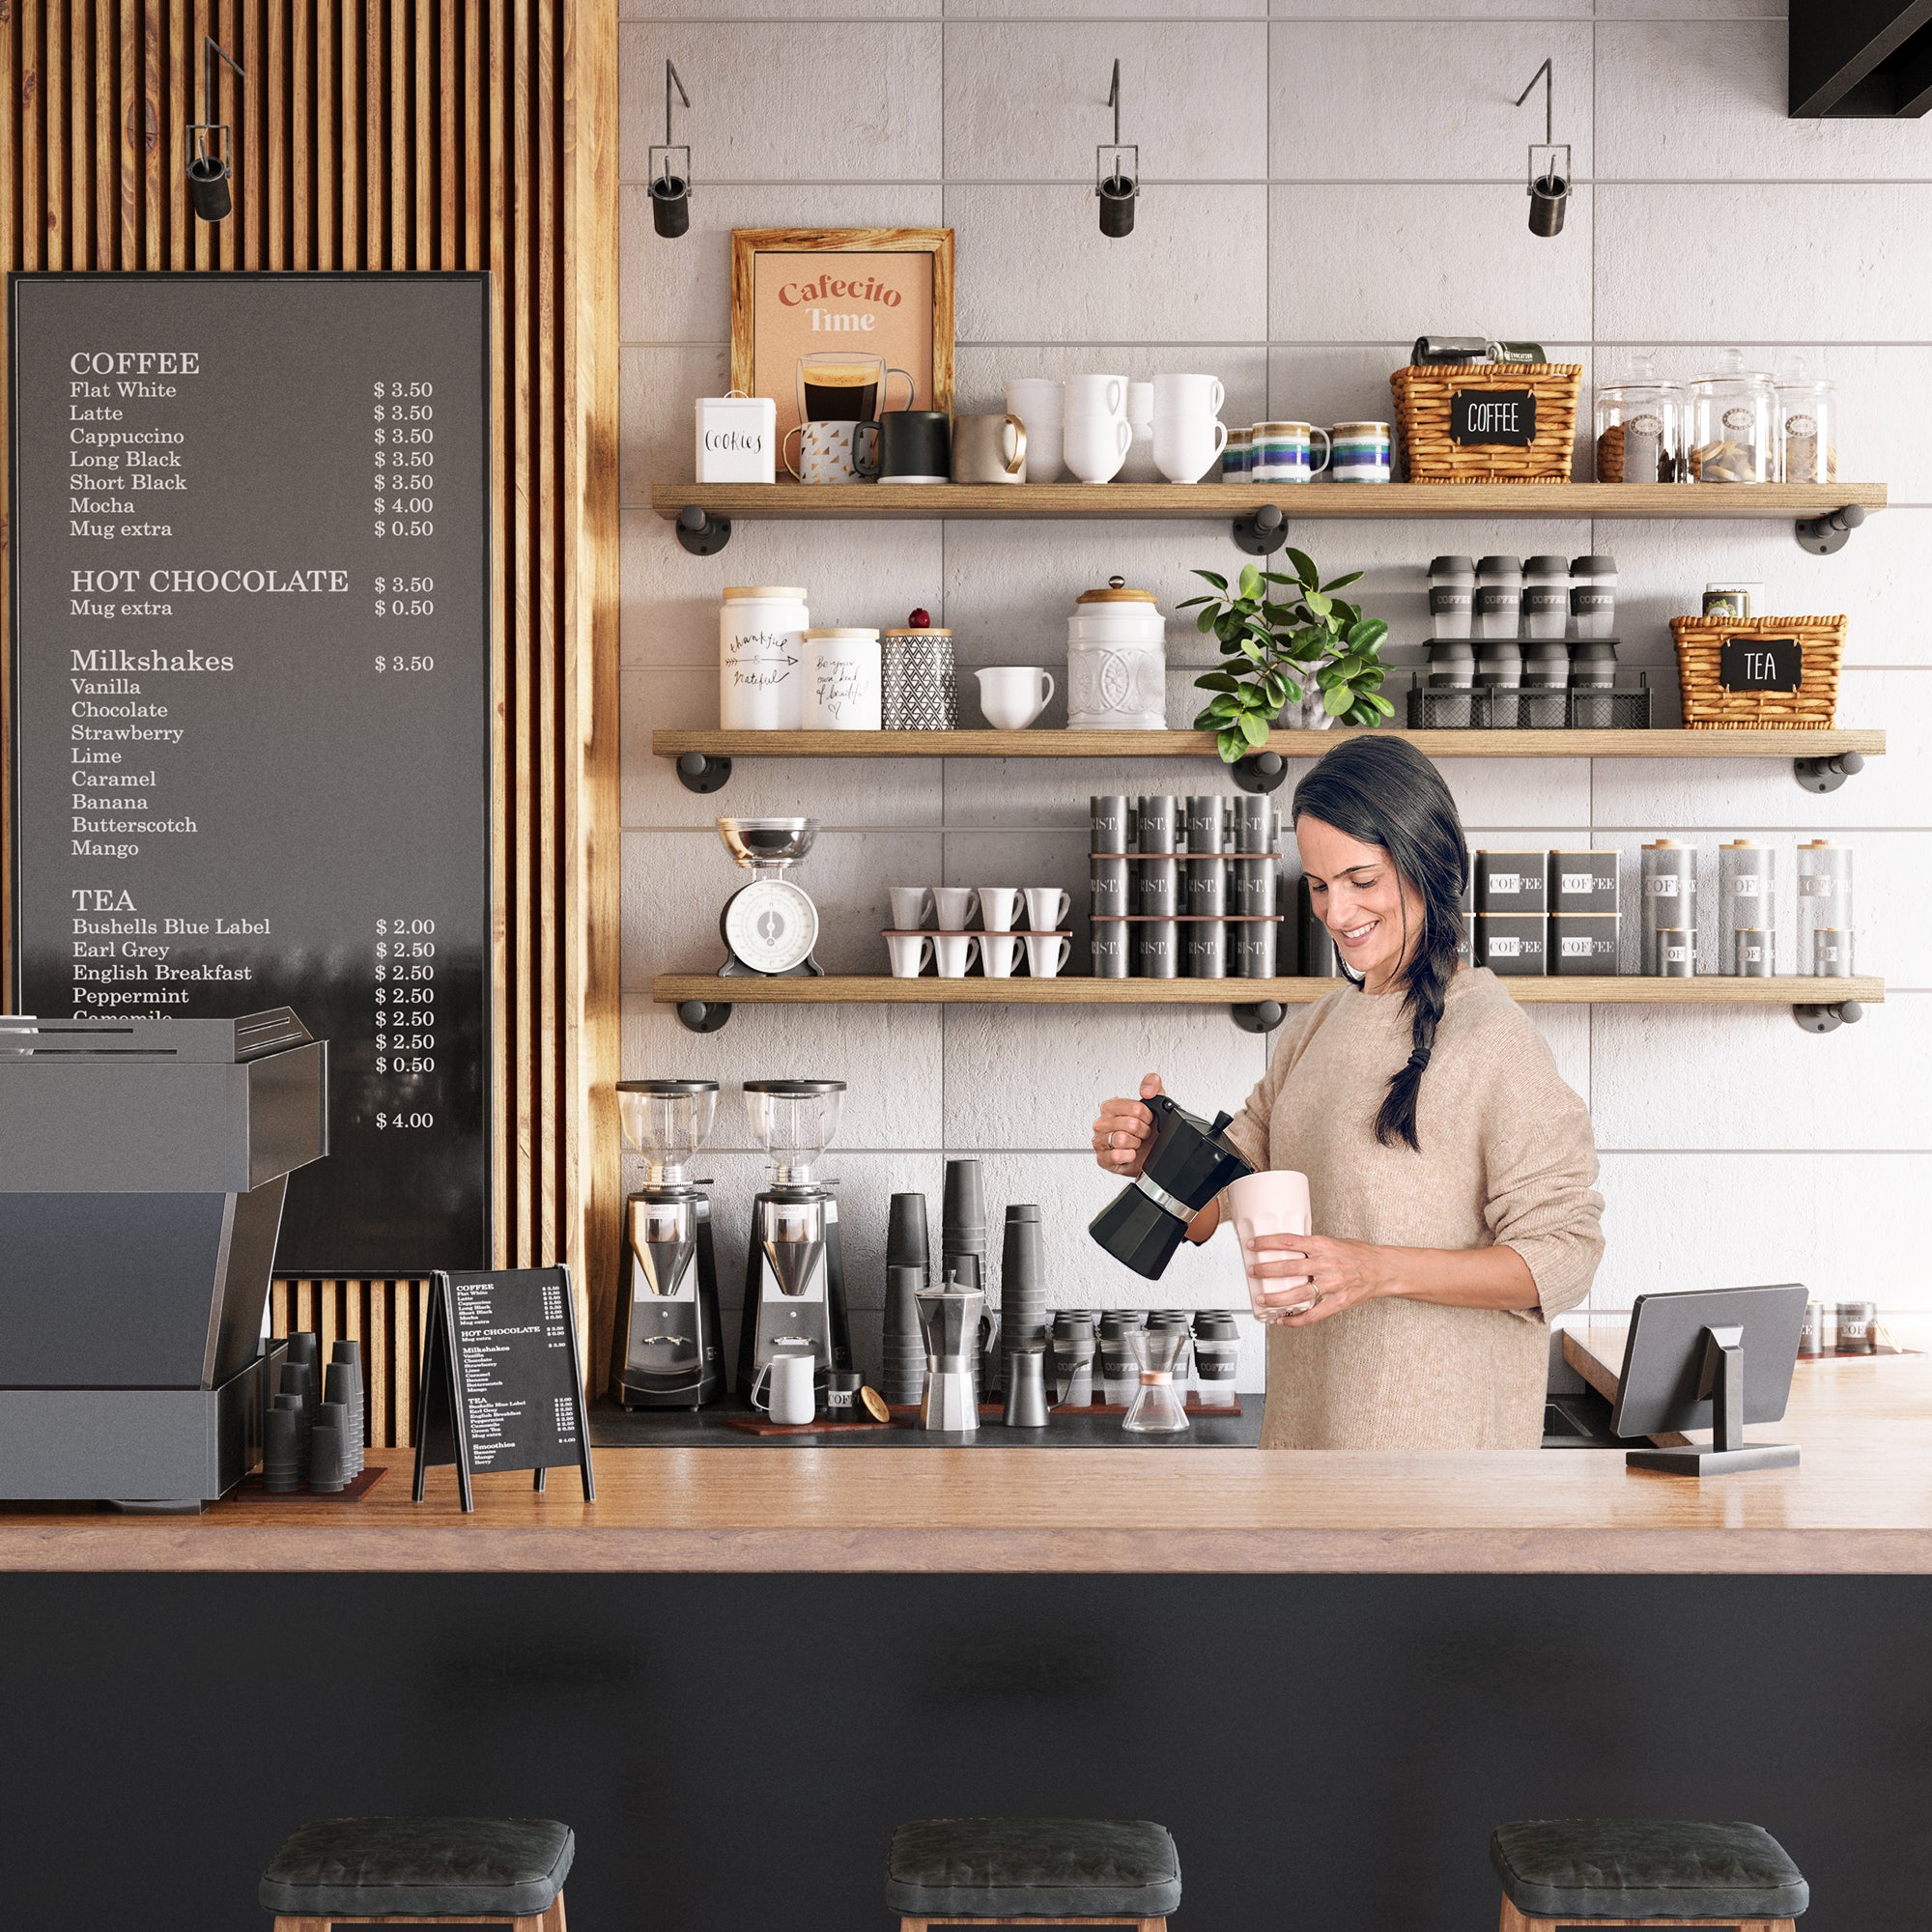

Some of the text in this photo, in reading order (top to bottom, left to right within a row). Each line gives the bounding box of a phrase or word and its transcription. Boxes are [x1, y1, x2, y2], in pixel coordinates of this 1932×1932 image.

[778, 274, 902, 308] Cafecito
[805, 307, 876, 332] Time
[70, 352, 200, 375] COFFEE
[69, 381, 111, 398] Flat
[116, 381, 177, 398] White
[69, 404, 124, 421] Latte
[1467, 402, 1520, 433] COFFEE
[70, 427, 185, 448] Cappuccino
[69, 450, 120, 470] Long
[125, 450, 183, 468] Black
[70, 473, 126, 491] Short
[130, 473, 188, 491] Black
[69, 497, 135, 514] Mocha
[69, 520, 116, 540] Mug
[120, 522, 173, 537] extra
[71, 569, 140, 593] HOT
[149, 569, 349, 593] CHOCOLATE
[70, 599, 116, 619] Mug
[121, 601, 174, 616] extra
[70, 648, 235, 672] Milkshakes
[1745, 652, 1776, 681] TEA
[70, 678, 142, 695] Vanilla
[71, 700, 168, 718] Chocolate
[71, 724, 185, 744] Strawberry
[71, 747, 123, 764] Lime
[71, 770, 156, 787] Caramel
[71, 793, 149, 810] Banana
[71, 816, 198, 833] Butterscotch
[71, 839, 139, 860] Mango
[1490, 877, 1543, 890] COFFEE
[1562, 877, 1615, 890] COFFEE
[71, 889, 138, 912] TEA
[71, 918, 157, 935] Bushells
[163, 918, 210, 935] Blue
[214, 918, 271, 935] Label
[72, 941, 116, 957] Earl
[121, 941, 170, 961] Grey
[1490, 941, 1543, 953] COFFEE
[1562, 941, 1615, 953] COFFEE
[72, 964, 149, 984] English
[155, 963, 253, 981] Breakfast
[71, 986, 190, 1008] Peppermint
[483, 1326, 541, 1336] CHOCOLATE
[463, 1345, 510, 1353] Milkshakes
[472, 1441, 516, 1450] Smoothies
